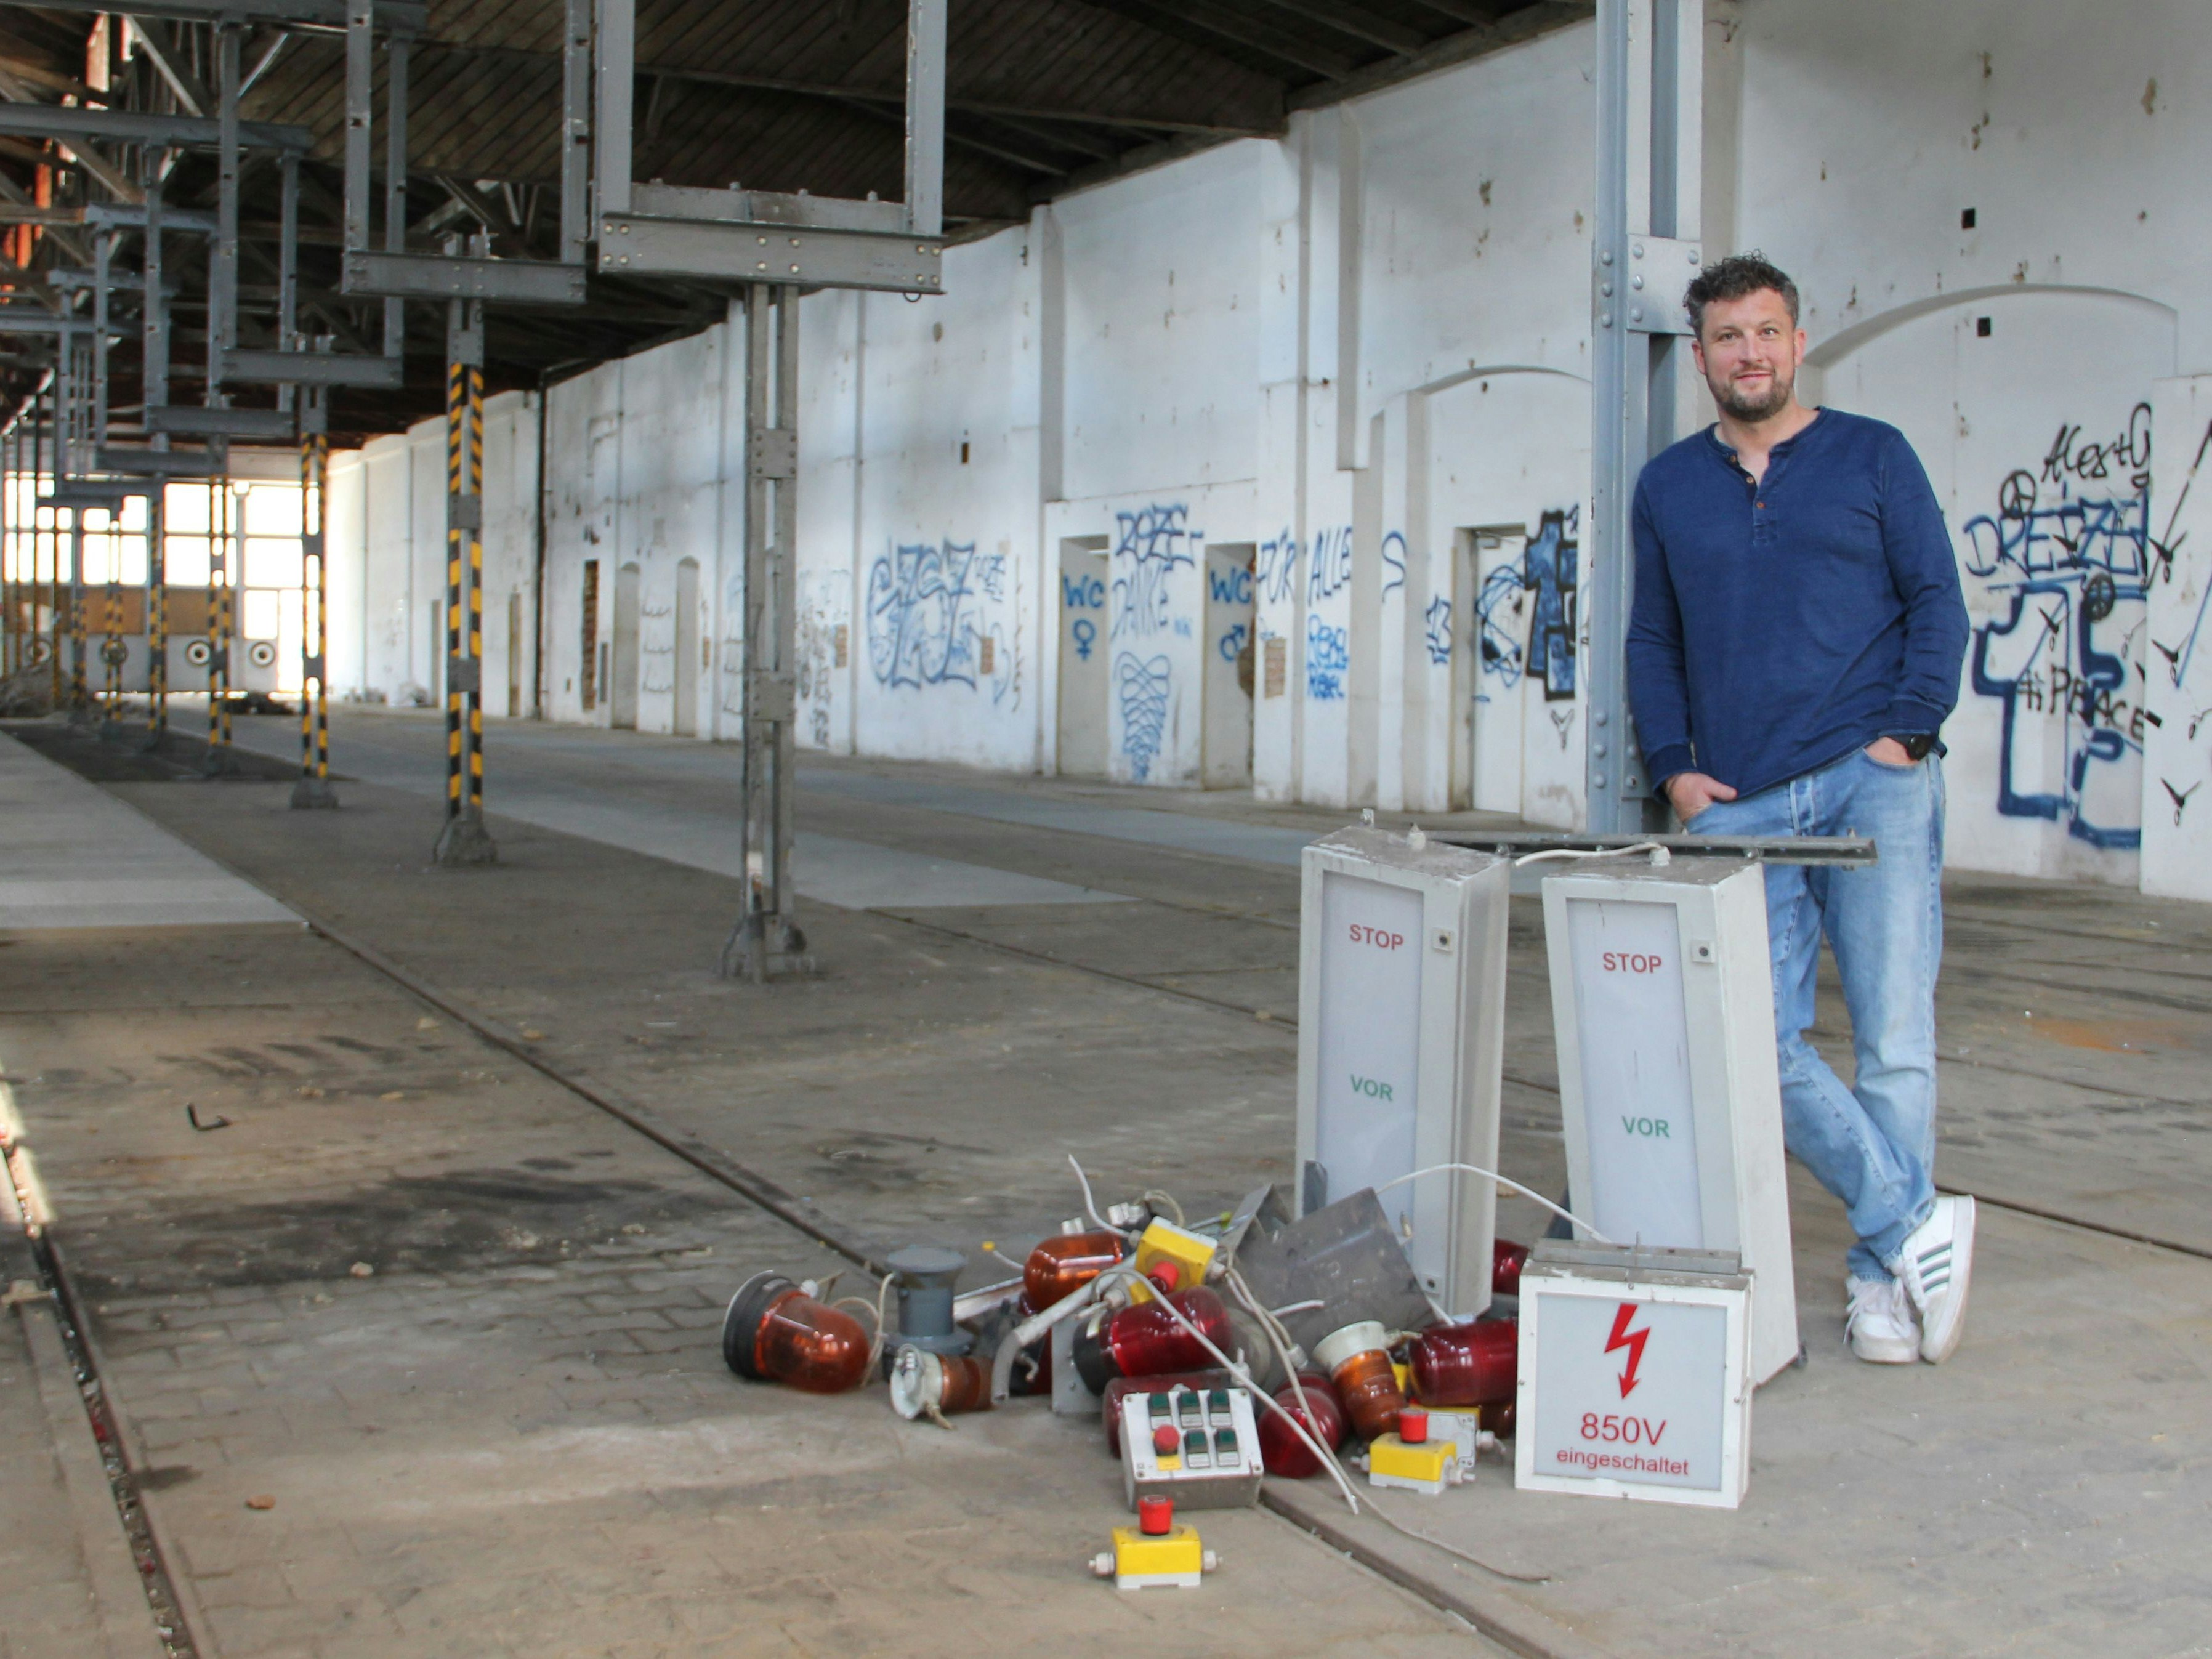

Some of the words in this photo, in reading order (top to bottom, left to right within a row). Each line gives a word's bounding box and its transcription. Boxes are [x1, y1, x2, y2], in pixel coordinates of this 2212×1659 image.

[1064, 574, 1104, 607] WC
[1211, 567, 1251, 603] WC
[1350, 924, 1404, 950] STOP
[1602, 952, 1662, 974] STOP
[1350, 1074, 1393, 1102] VOR
[1621, 1115, 1670, 1138] VOR
[1580, 1412, 1666, 1446] 850V
[1556, 1447, 1689, 1475] eingeschaltet
